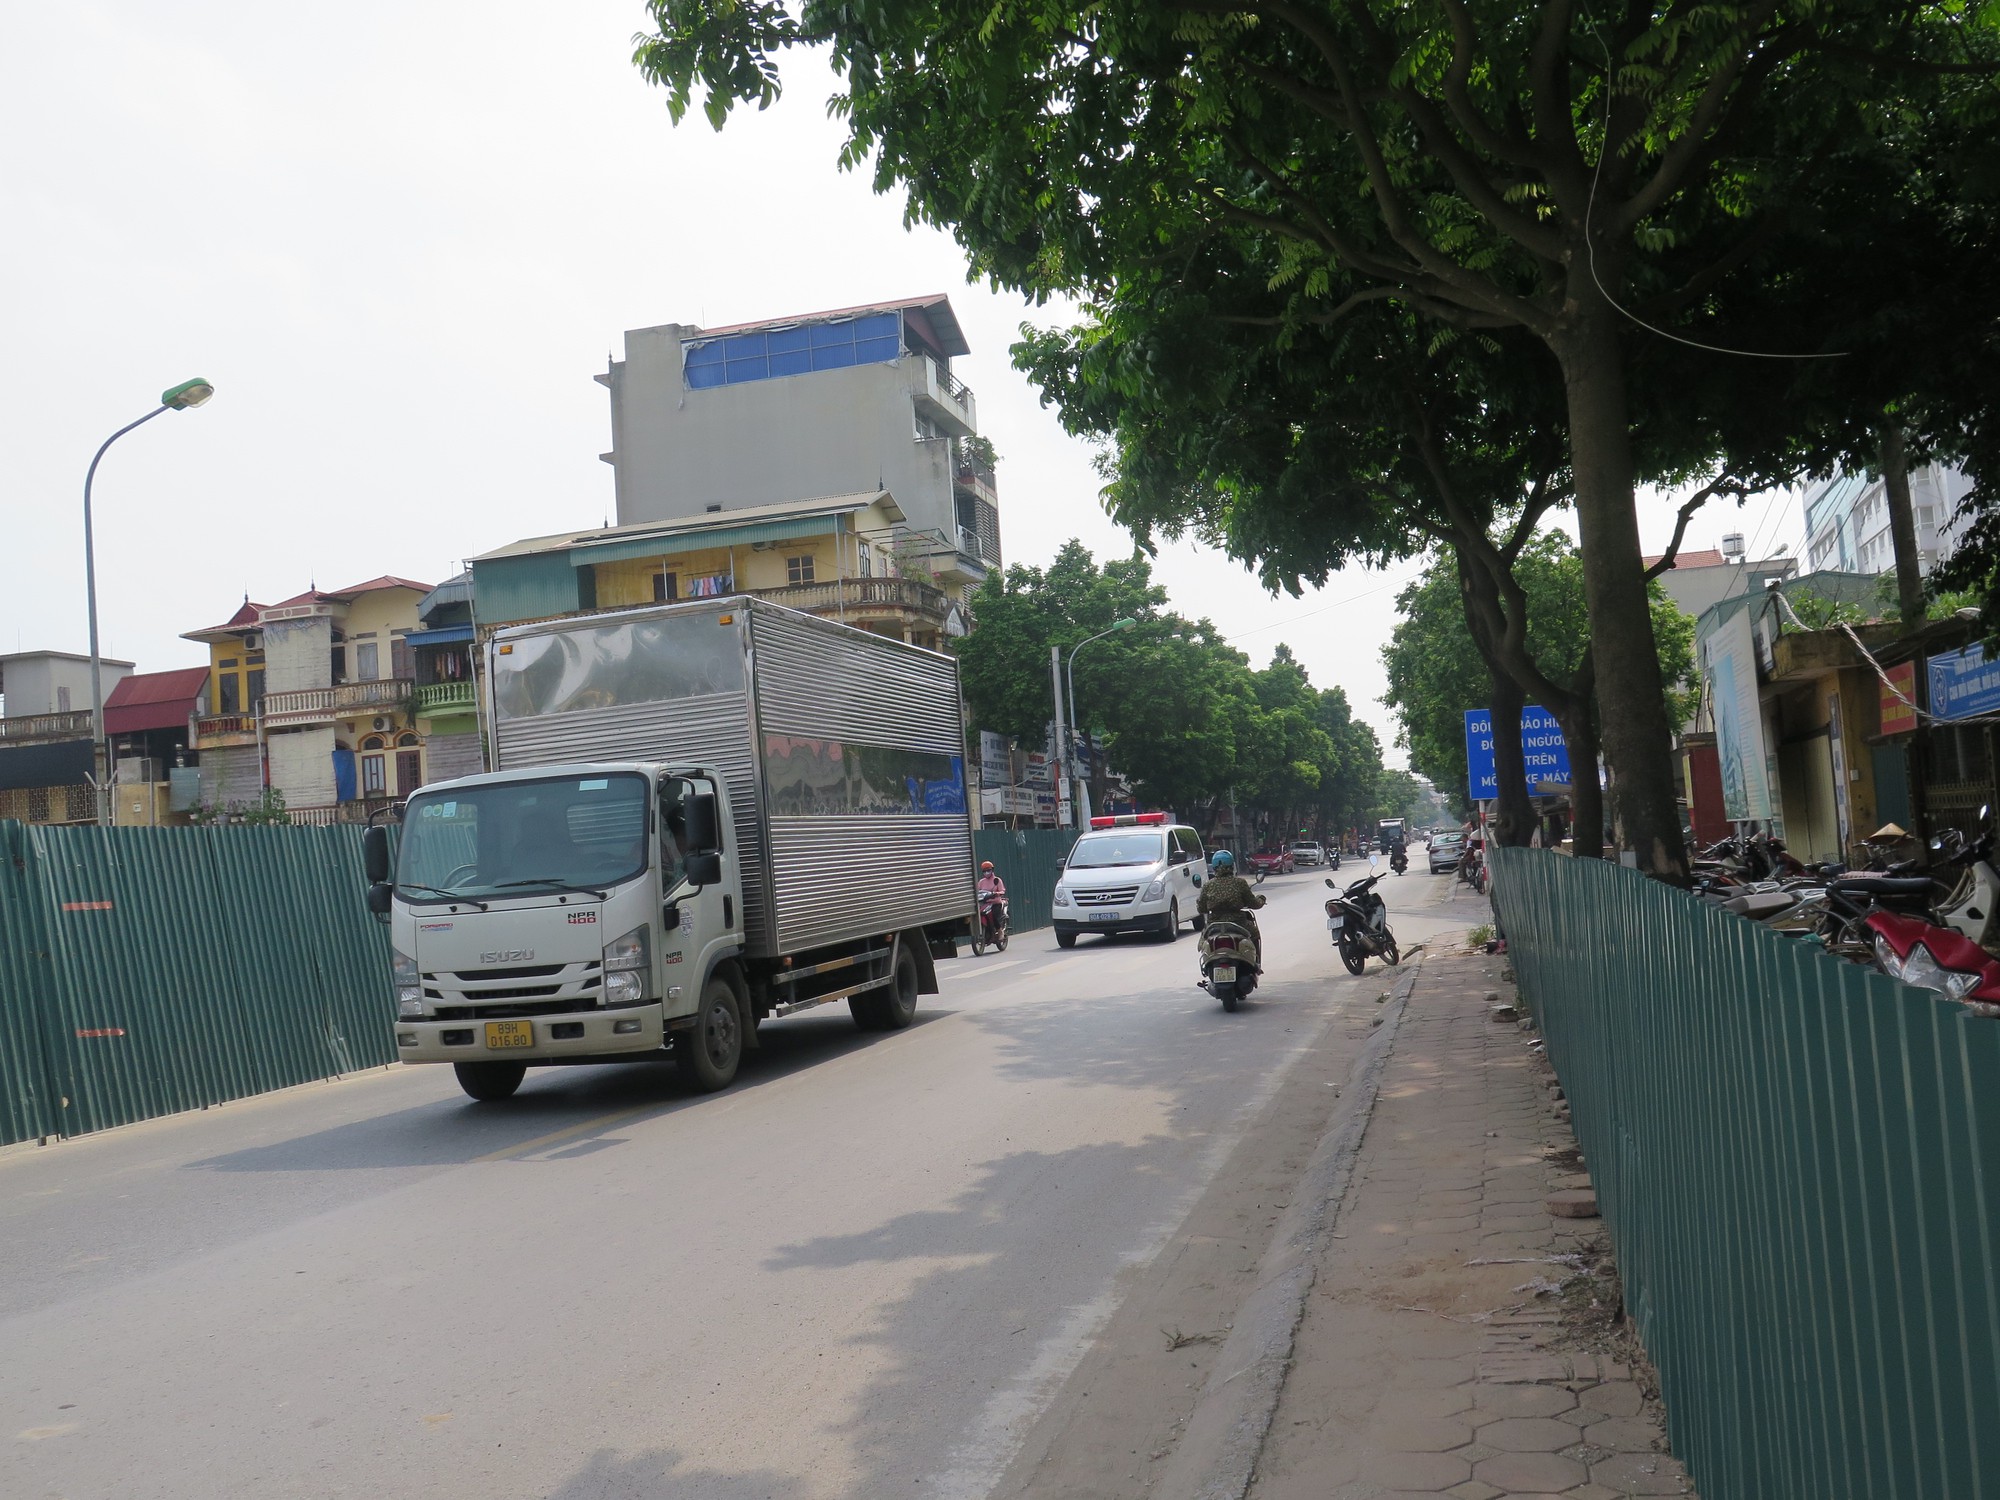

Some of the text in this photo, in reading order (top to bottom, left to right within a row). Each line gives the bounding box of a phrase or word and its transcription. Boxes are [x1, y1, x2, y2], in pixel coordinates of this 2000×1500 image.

[1471, 719, 1491, 734] ĐỘI
[1524, 752, 1557, 766] TRÊN
[1543, 769, 1569, 783] MÁY
[567, 911, 596, 919] NPR
[480, 948, 535, 964] ISUZU
[666, 951, 683, 959] NPR
[666, 957, 683, 965] 400
[498, 1022, 518, 1034] 89H
[491, 1034, 527, 1047] 016.80
